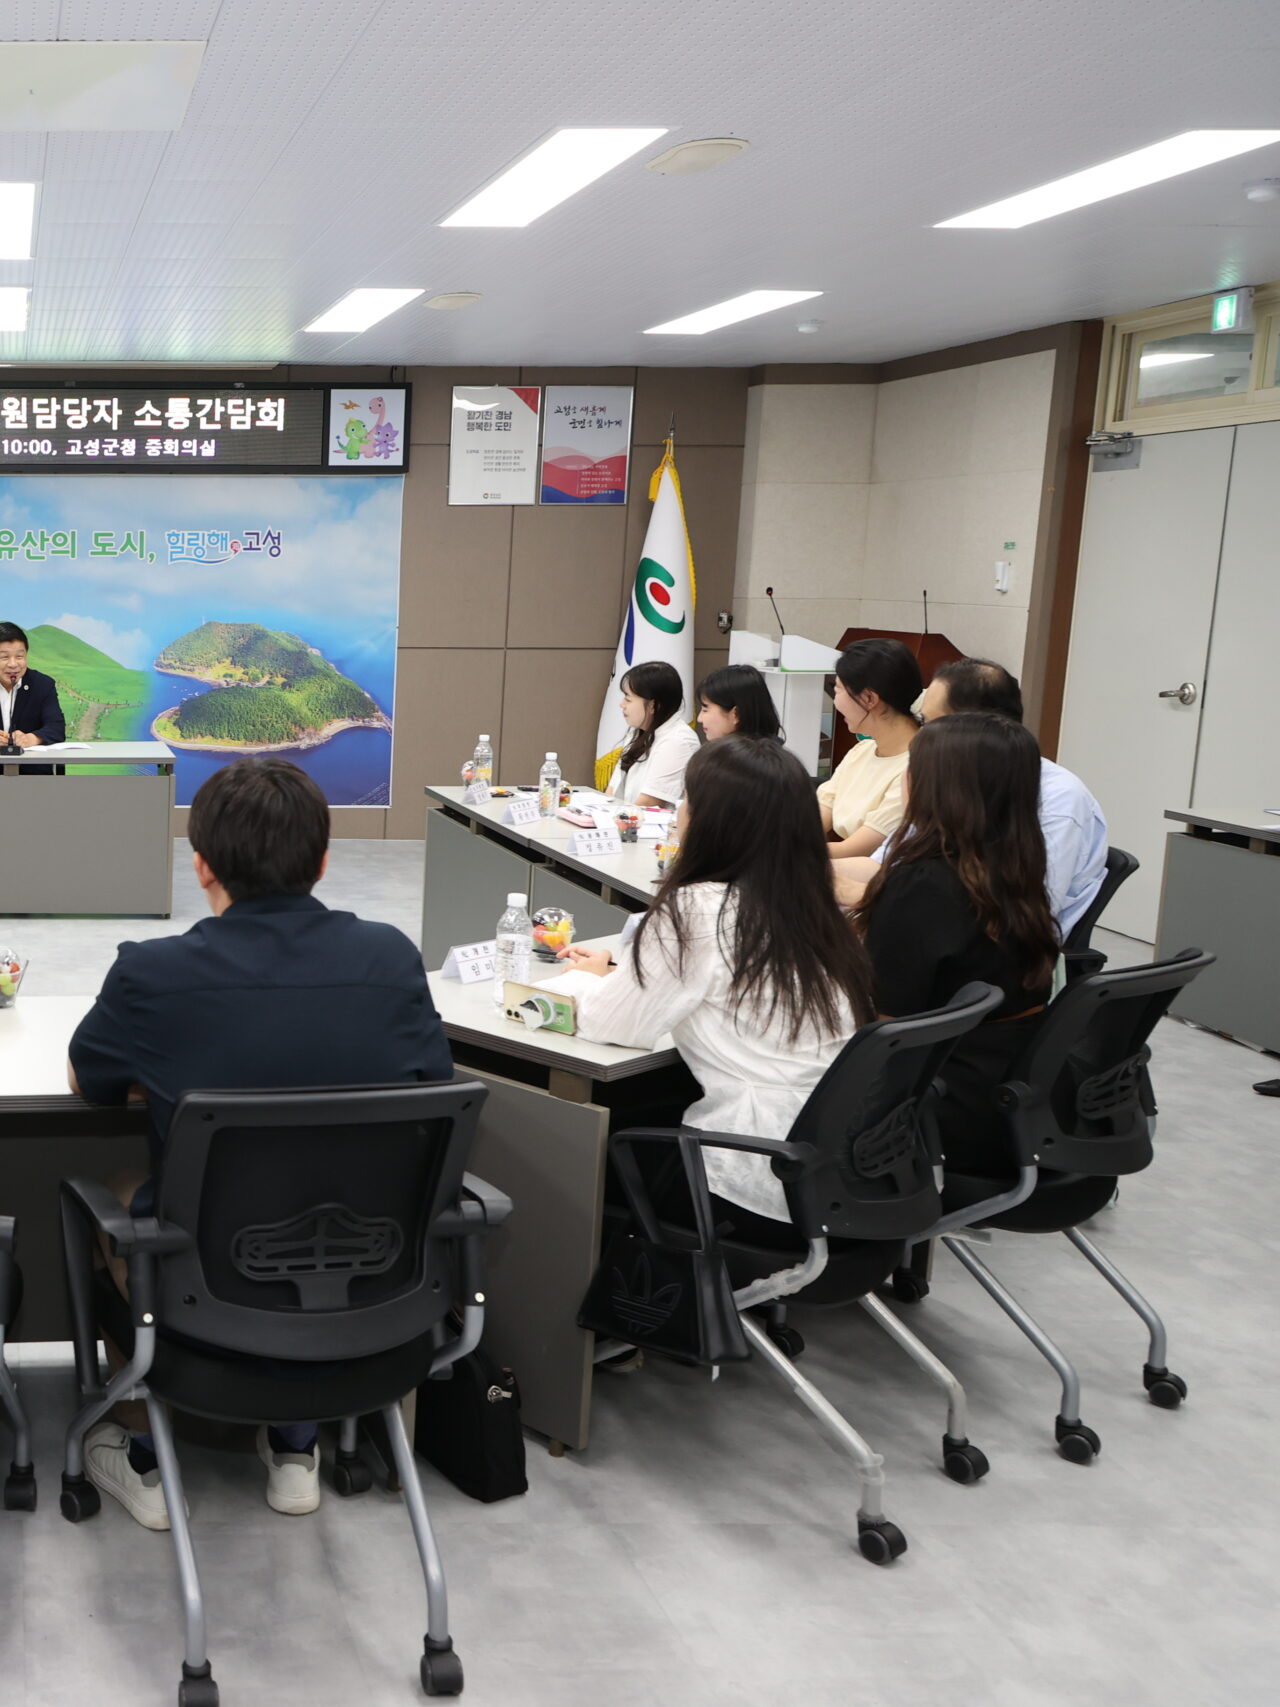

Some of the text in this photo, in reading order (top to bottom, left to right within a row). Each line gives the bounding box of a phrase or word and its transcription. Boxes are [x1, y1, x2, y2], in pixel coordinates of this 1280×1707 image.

[133, 397, 286, 431] 소통간담회
[496, 410, 513, 421] 경남
[466, 421, 512, 432] 행복한 도민
[2, 439, 58, 456] 10:00,
[65, 438, 137, 457] 고성군청
[144, 438, 216, 457] 중회의실
[89, 529, 156, 562] 도시,
[242, 527, 282, 558] 고성
